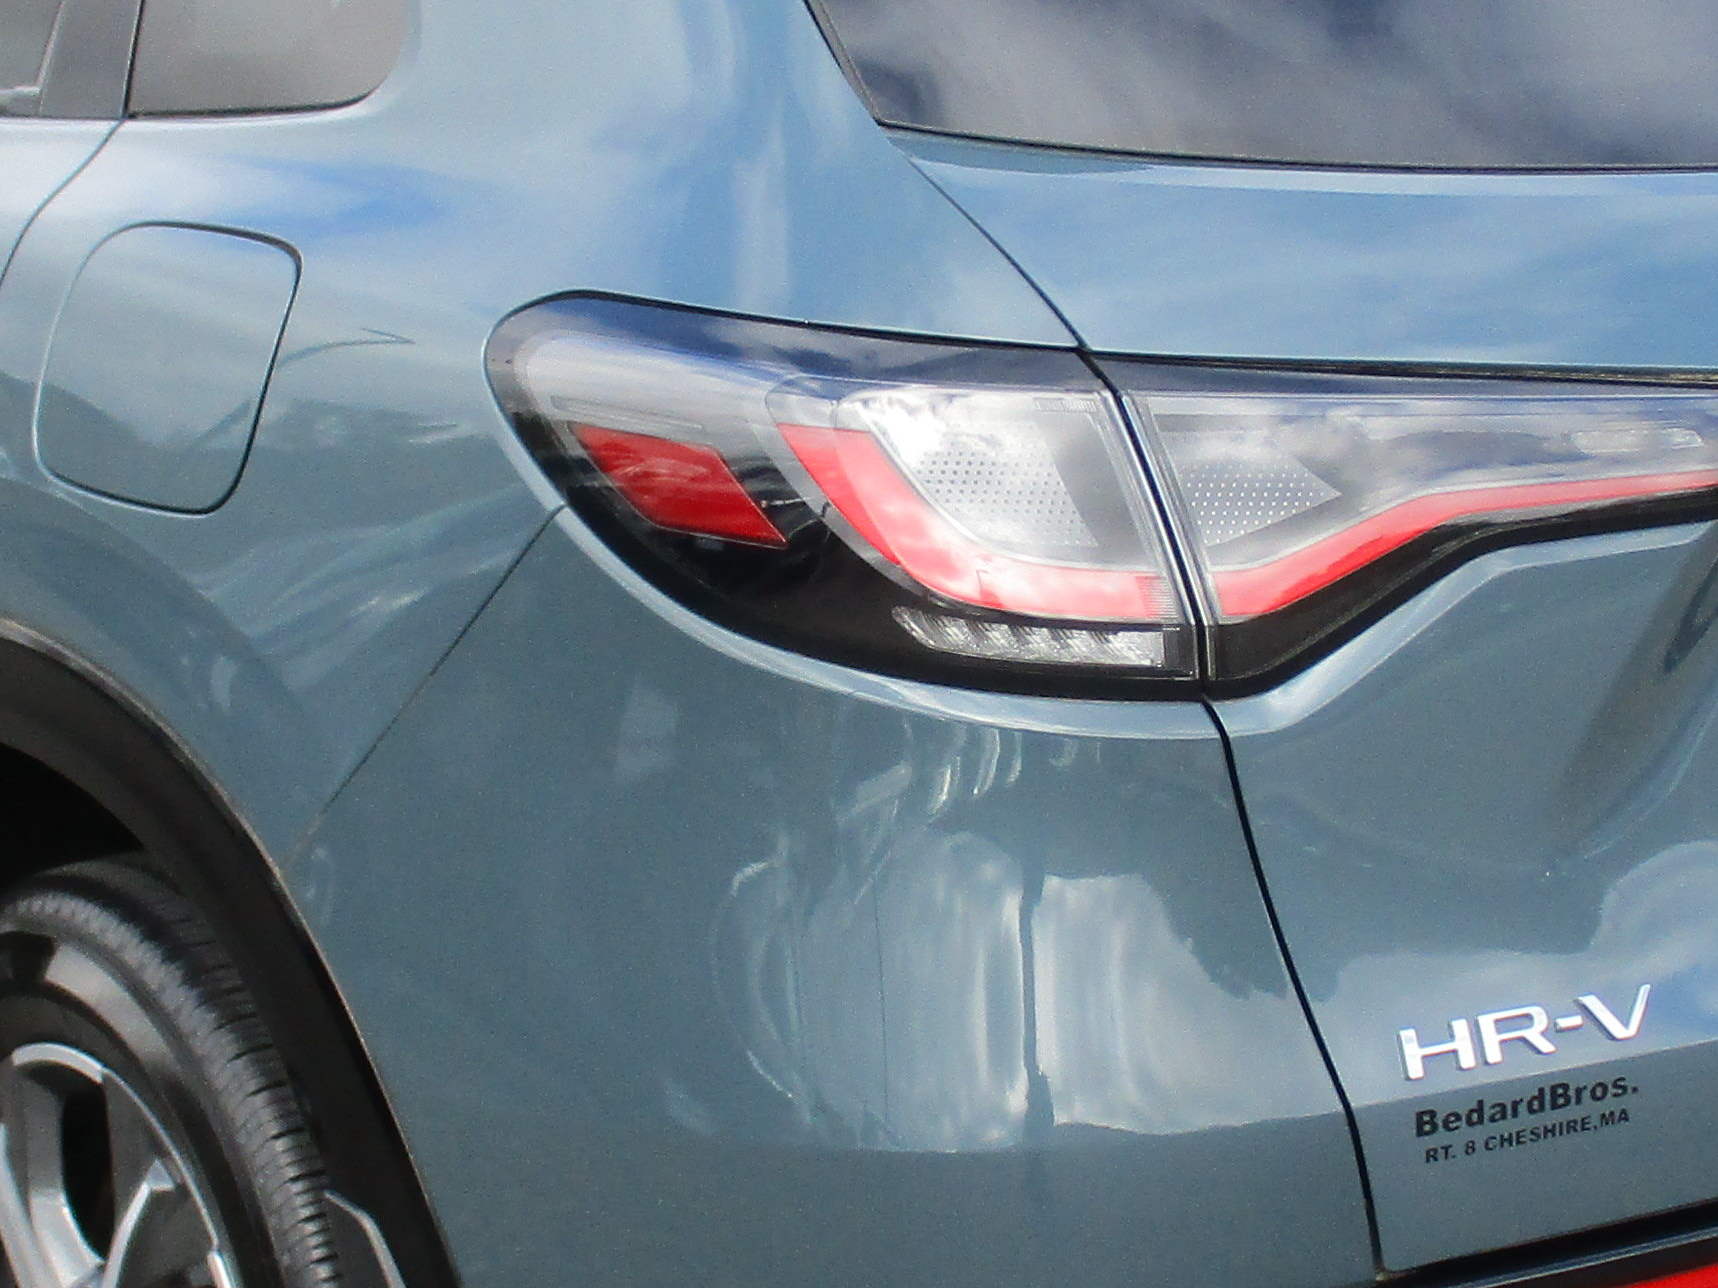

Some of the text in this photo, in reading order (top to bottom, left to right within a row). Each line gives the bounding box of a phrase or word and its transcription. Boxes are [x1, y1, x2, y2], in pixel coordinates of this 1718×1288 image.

[1396, 983, 1651, 1080] HR-V
[1425, 1145, 1456, 1164] RT.
[1463, 1139, 1477, 1157] 8
